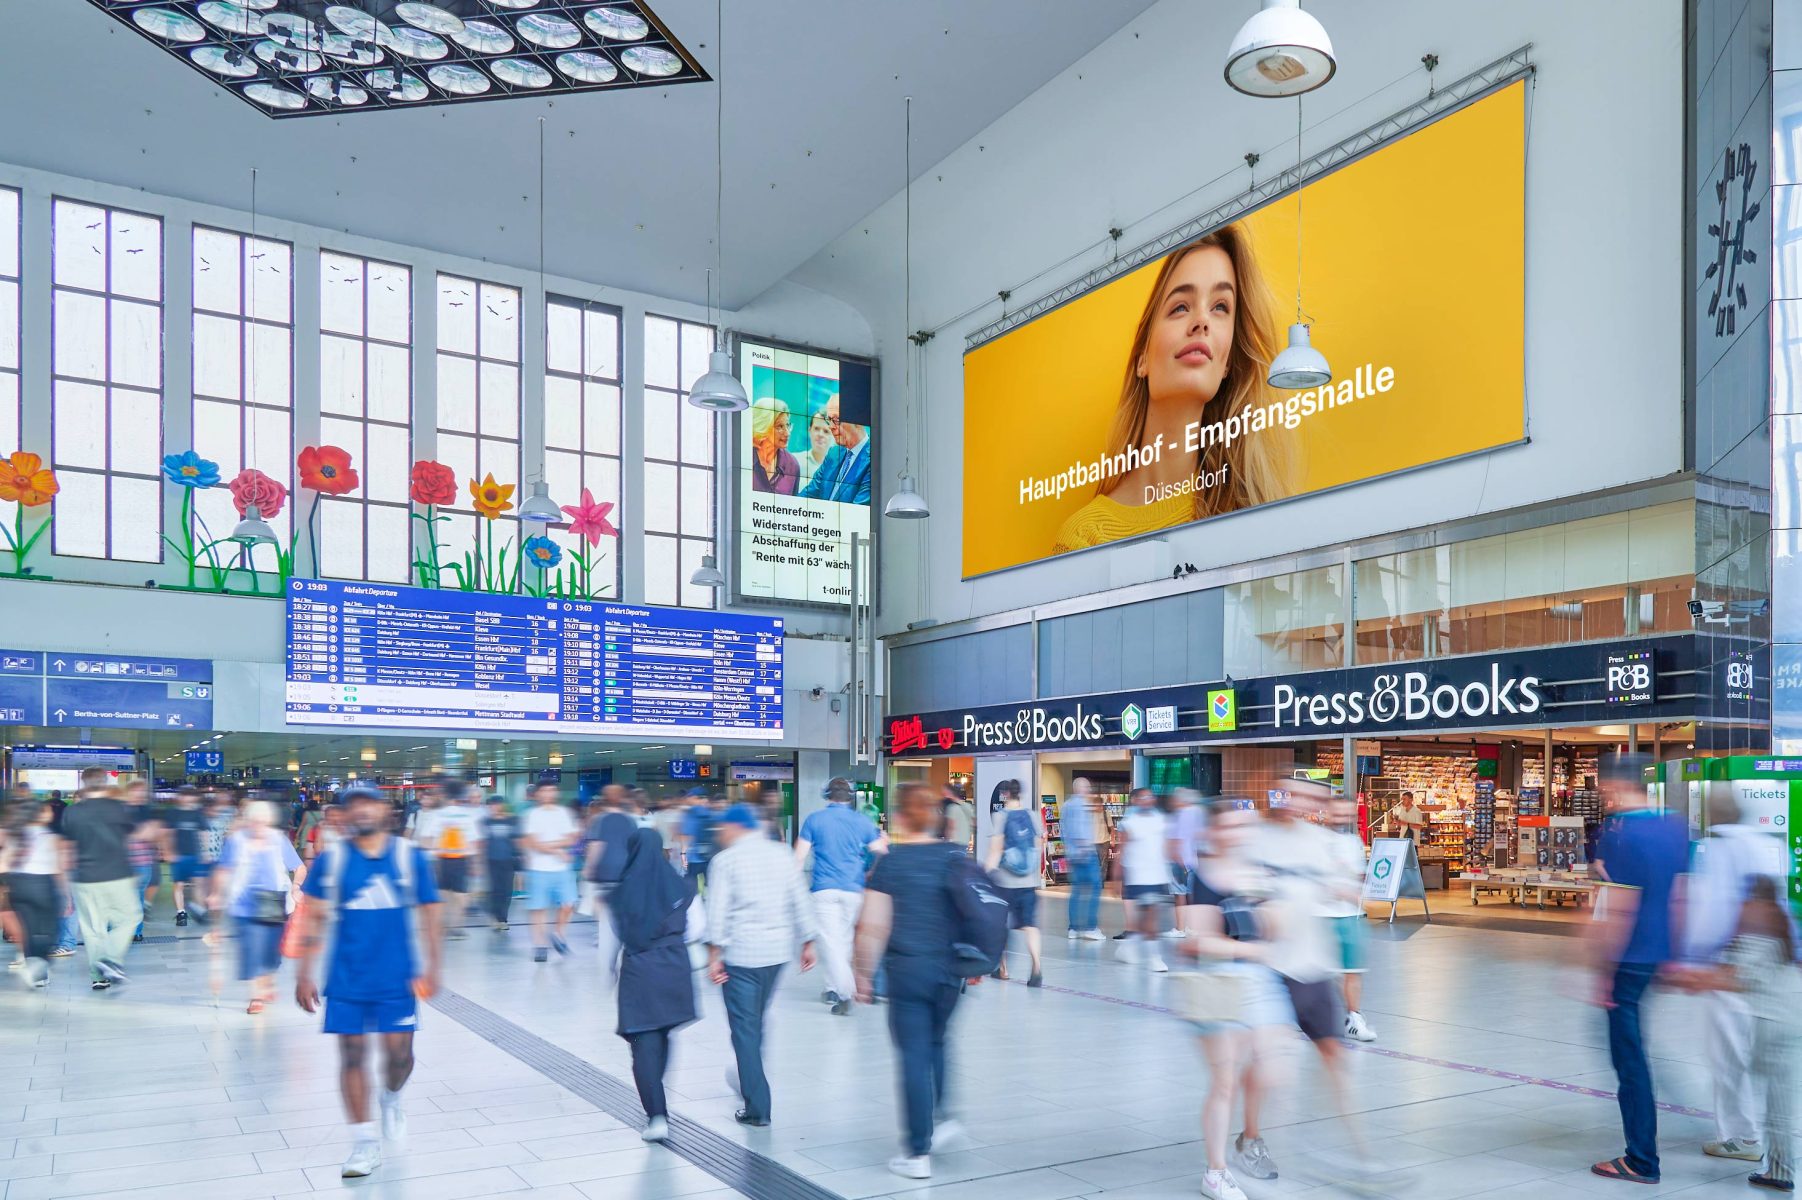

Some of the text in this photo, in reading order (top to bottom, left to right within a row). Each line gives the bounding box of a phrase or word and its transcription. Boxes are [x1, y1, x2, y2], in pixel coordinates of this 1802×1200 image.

[752, 351, 771, 360] Politik
[1019, 434, 1163, 504] Hauptbahnhof
[1185, 364, 1395, 452] Empfangshalle
[1144, 464, 1228, 505] Düsseldorf
[752, 502, 824, 519] Rentenreform:
[752, 518, 841, 538] Widerstand gegen
[752, 535, 834, 552] Abschaffung der
[752, 551, 785, 563] "Rente
[788, 556, 804, 566] mit
[807, 557, 823, 566] 63"
[307, 583, 328, 591] 19:03
[343, 586, 369, 594] Abfahrt
[1608, 664, 1650, 691] P&B
[74, 710, 160, 720] Bertha-von-Suttner-Platz
[1149, 710, 1171, 720] Tickets
[1149, 720, 1172, 730] Service
[1741, 788, 1786, 799] Tickets
